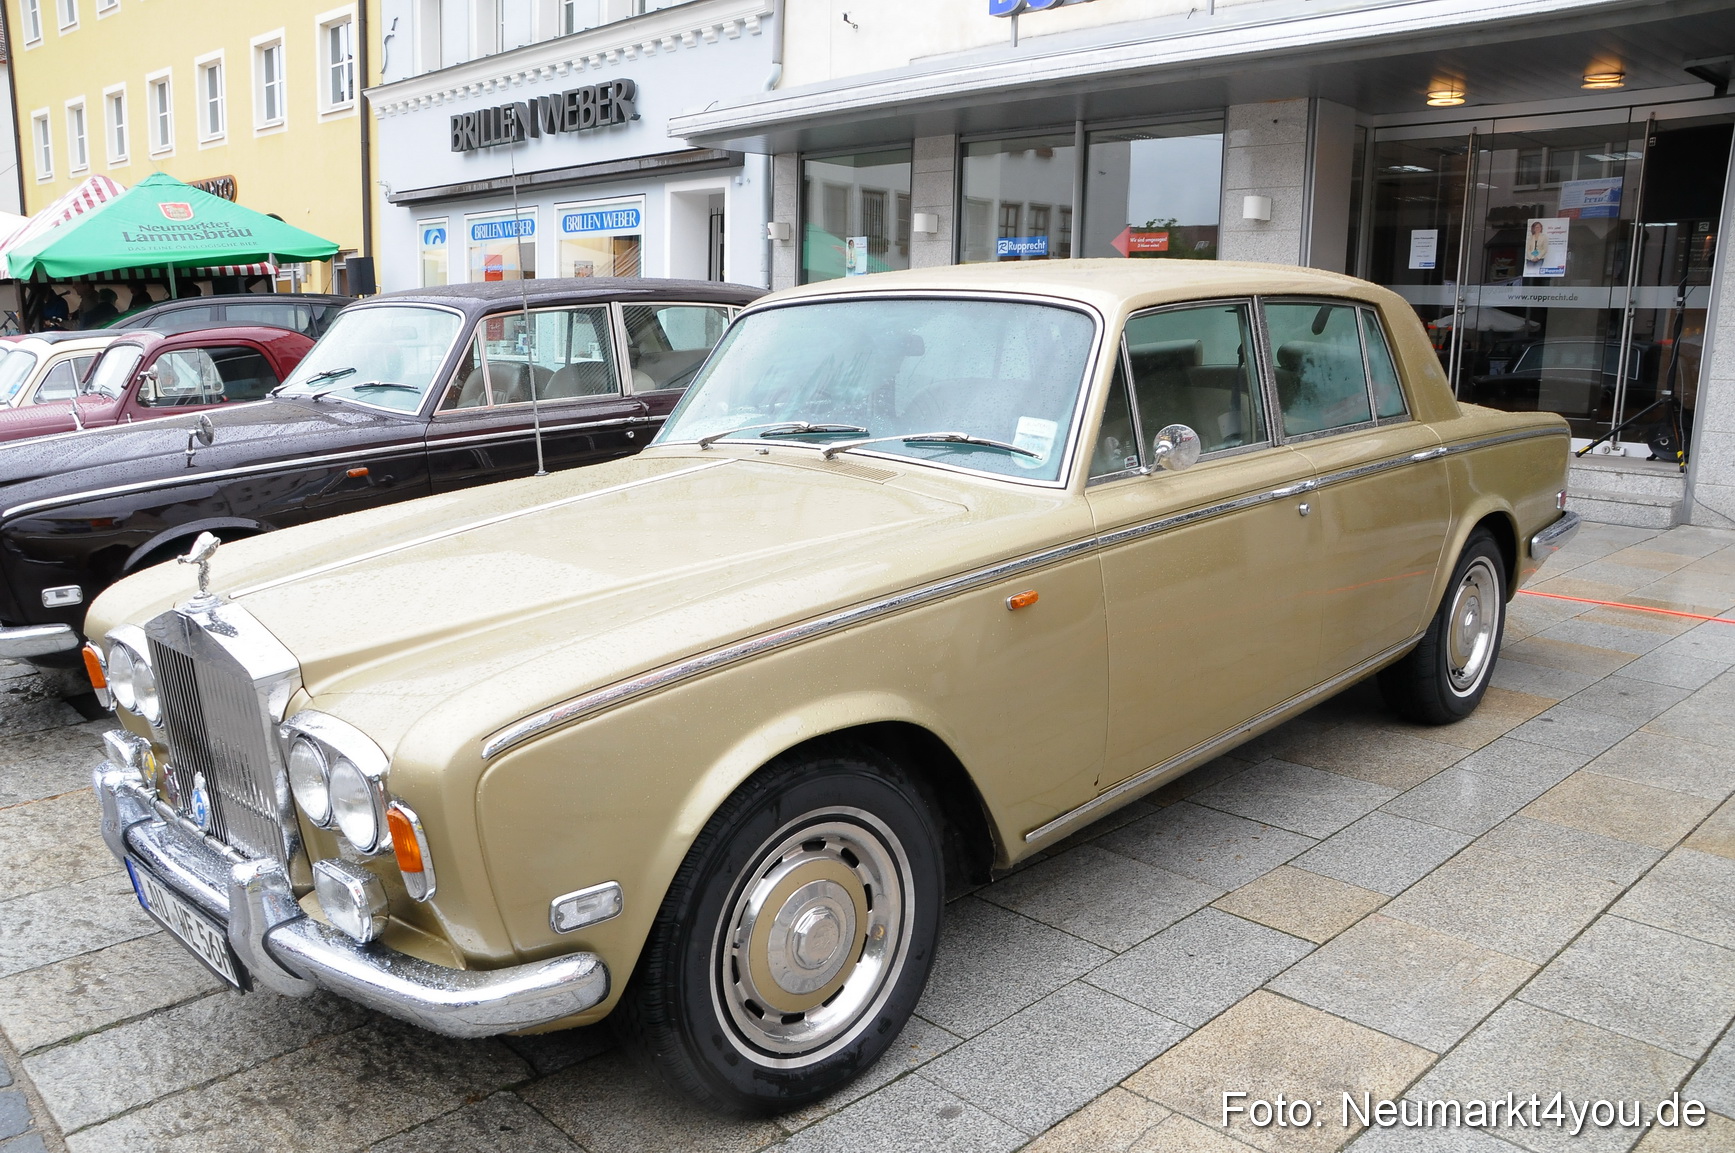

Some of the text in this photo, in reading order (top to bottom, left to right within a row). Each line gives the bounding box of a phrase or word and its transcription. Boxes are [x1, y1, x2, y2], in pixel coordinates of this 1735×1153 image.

[450, 78, 637, 152] BRILLEN WEBER
[139, 222, 230, 232] Neumarkter
[566, 210, 637, 231] BRILLEN WEBER
[123, 227, 253, 243] Lammsbräu
[474, 220, 532, 240] BRILLEN WEBER
[1008, 239, 1046, 253] Rupprecht
[1507, 293, 1579, 302] www.rupprecht.de
